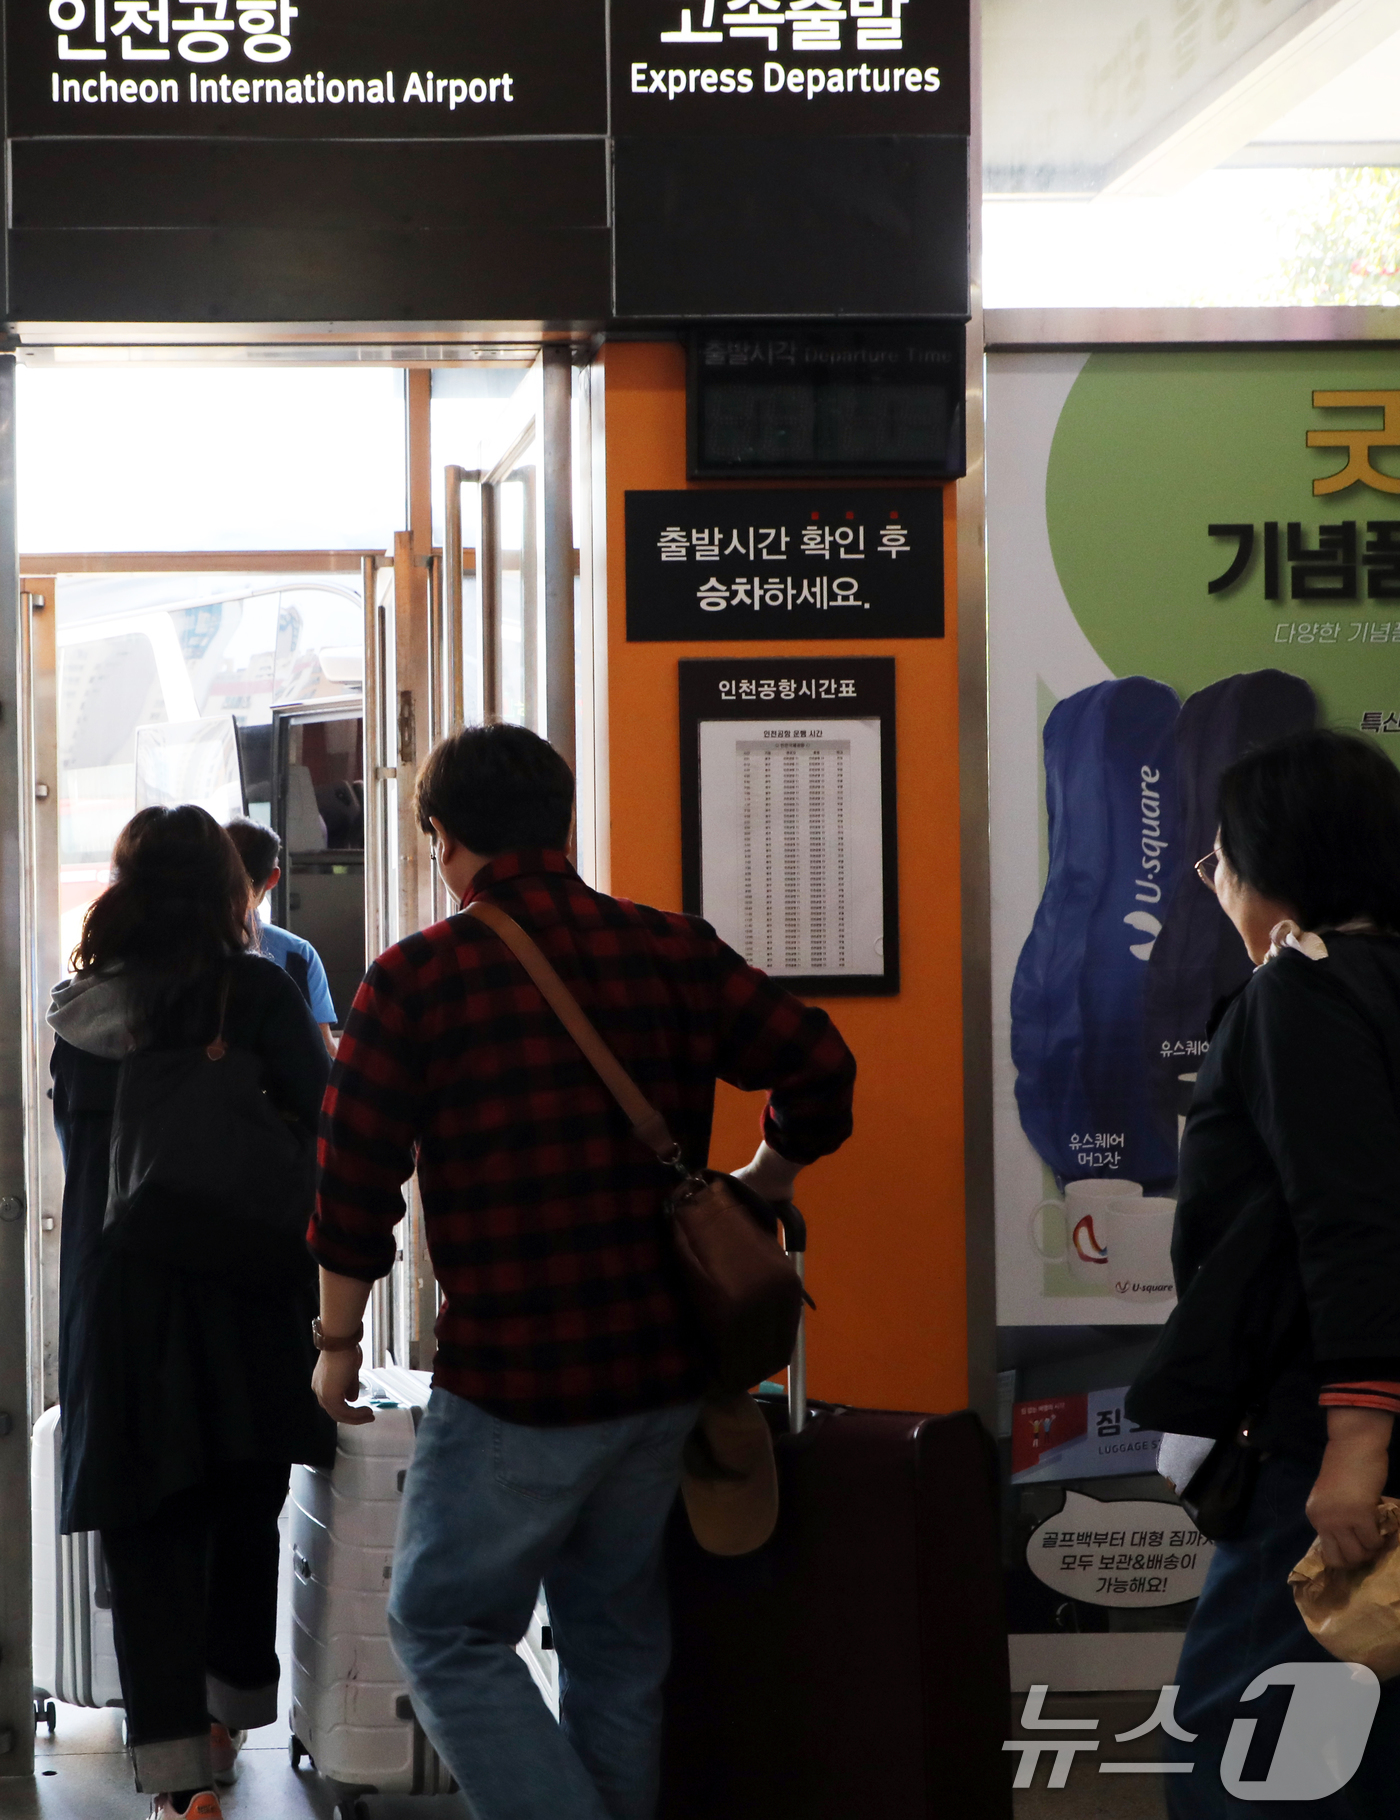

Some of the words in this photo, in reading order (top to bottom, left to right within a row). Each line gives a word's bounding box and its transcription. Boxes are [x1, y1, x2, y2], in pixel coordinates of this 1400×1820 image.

[48, 0, 299, 63] 인천공항
[51, 70, 179, 104] Incheon
[189, 70, 396, 104] International
[402, 70, 514, 111] Airport
[631, 62, 755, 101] Express
[763, 62, 941, 101] Departures
[703, 341, 797, 366] 출발시각
[804, 347, 898, 365] Departure
[906, 347, 952, 363] Time
[656, 526, 791, 561] 출발시간
[800, 525, 866, 560] 확인
[877, 524, 911, 559] 후
[696, 575, 870, 612] 승차하세요.
[1274, 622, 1341, 644] 다양한
[718, 678, 857, 701] 인천공항시간표
[763, 729, 791, 739] 인천공항
[809, 729, 823, 739] 시간
[1068, 1133, 1125, 1150] 유스퀘어
[1077, 1152, 1121, 1169] 머그잔
[1098, 1441, 1149, 1455] LUGGAGE
[1042, 1531, 1126, 1549] 골프백부터
[1130, 1531, 1165, 1548] 대형
[1059, 1554, 1094, 1571] 모두
[1098, 1553, 1197, 1570] 보관&배송이
[1095, 1576, 1168, 1594] 가능해요!
